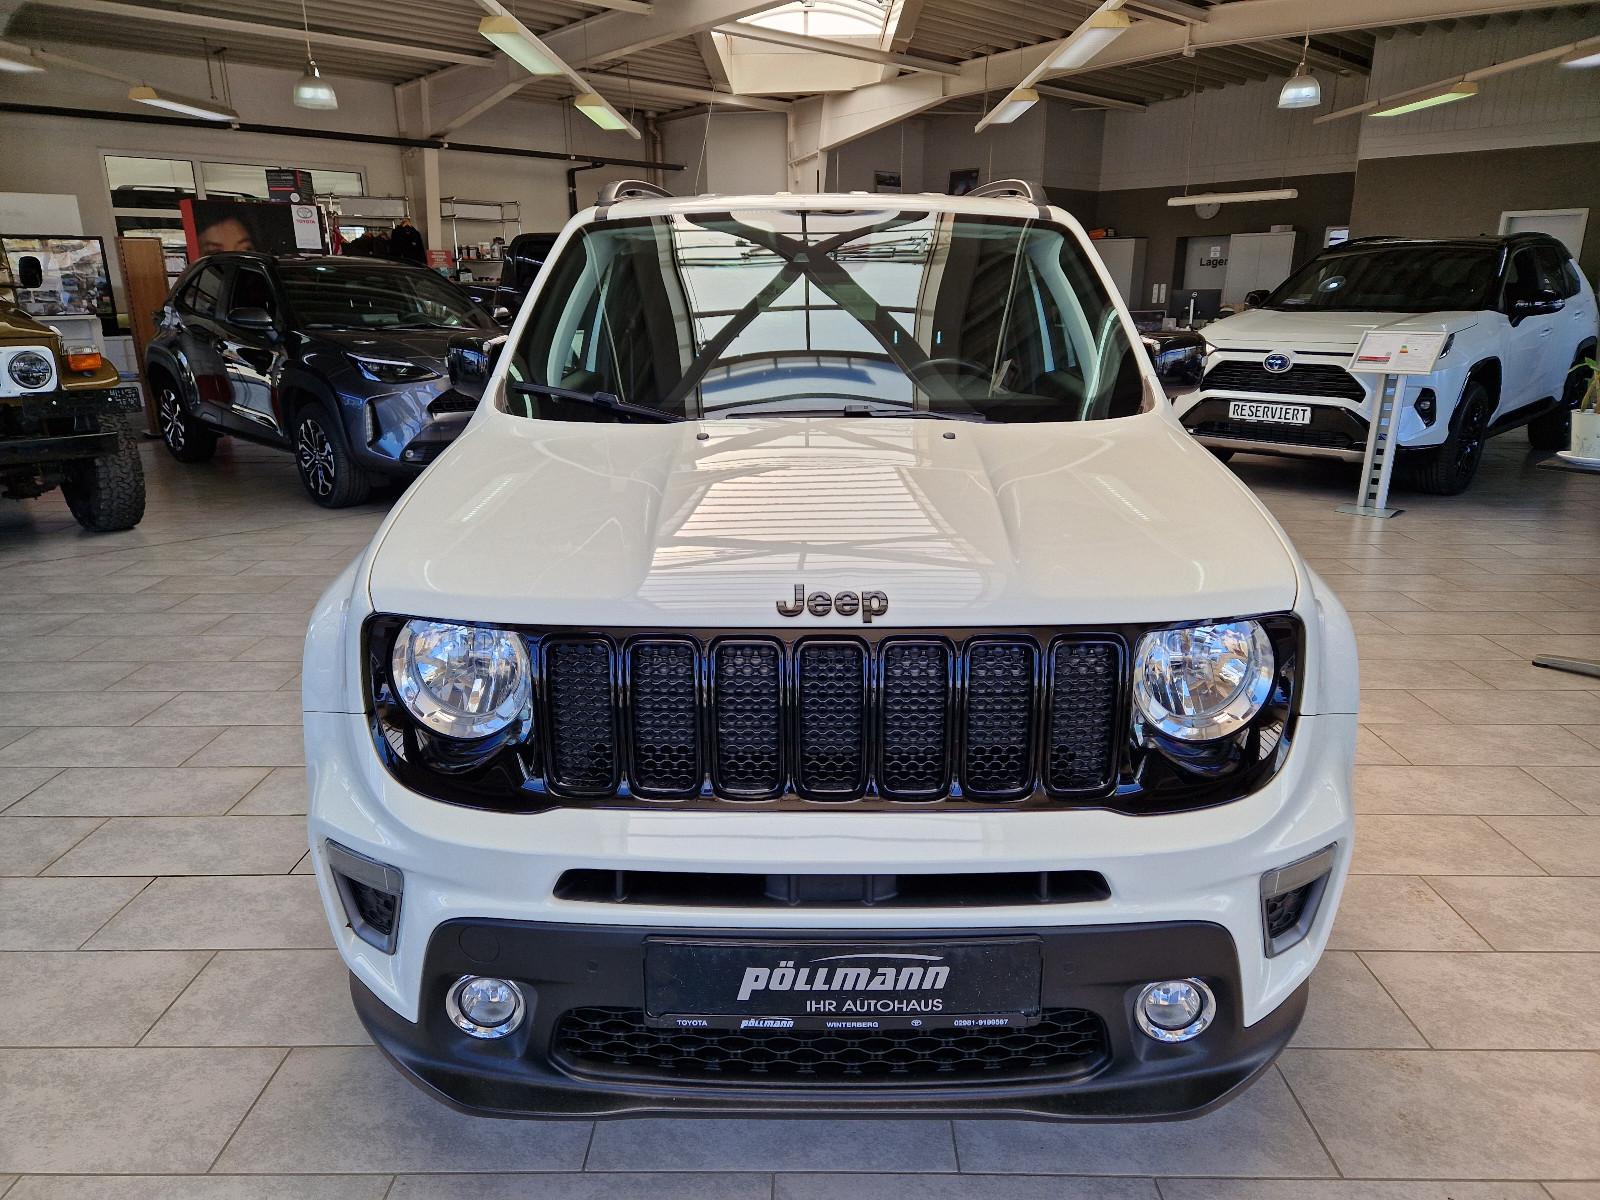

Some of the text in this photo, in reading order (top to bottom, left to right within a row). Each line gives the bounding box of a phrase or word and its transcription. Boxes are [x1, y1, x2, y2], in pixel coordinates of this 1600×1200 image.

[1199, 257, 1228, 268] Lager
[1232, 403, 1308, 422] RESERVIERT
[776, 583, 889, 624] Jeep
[806, 998, 943, 1012] IHR AUTOHAUS
[676, 1019, 708, 1027] TOYOTA
[826, 1020, 879, 1028] WINTERBERG
